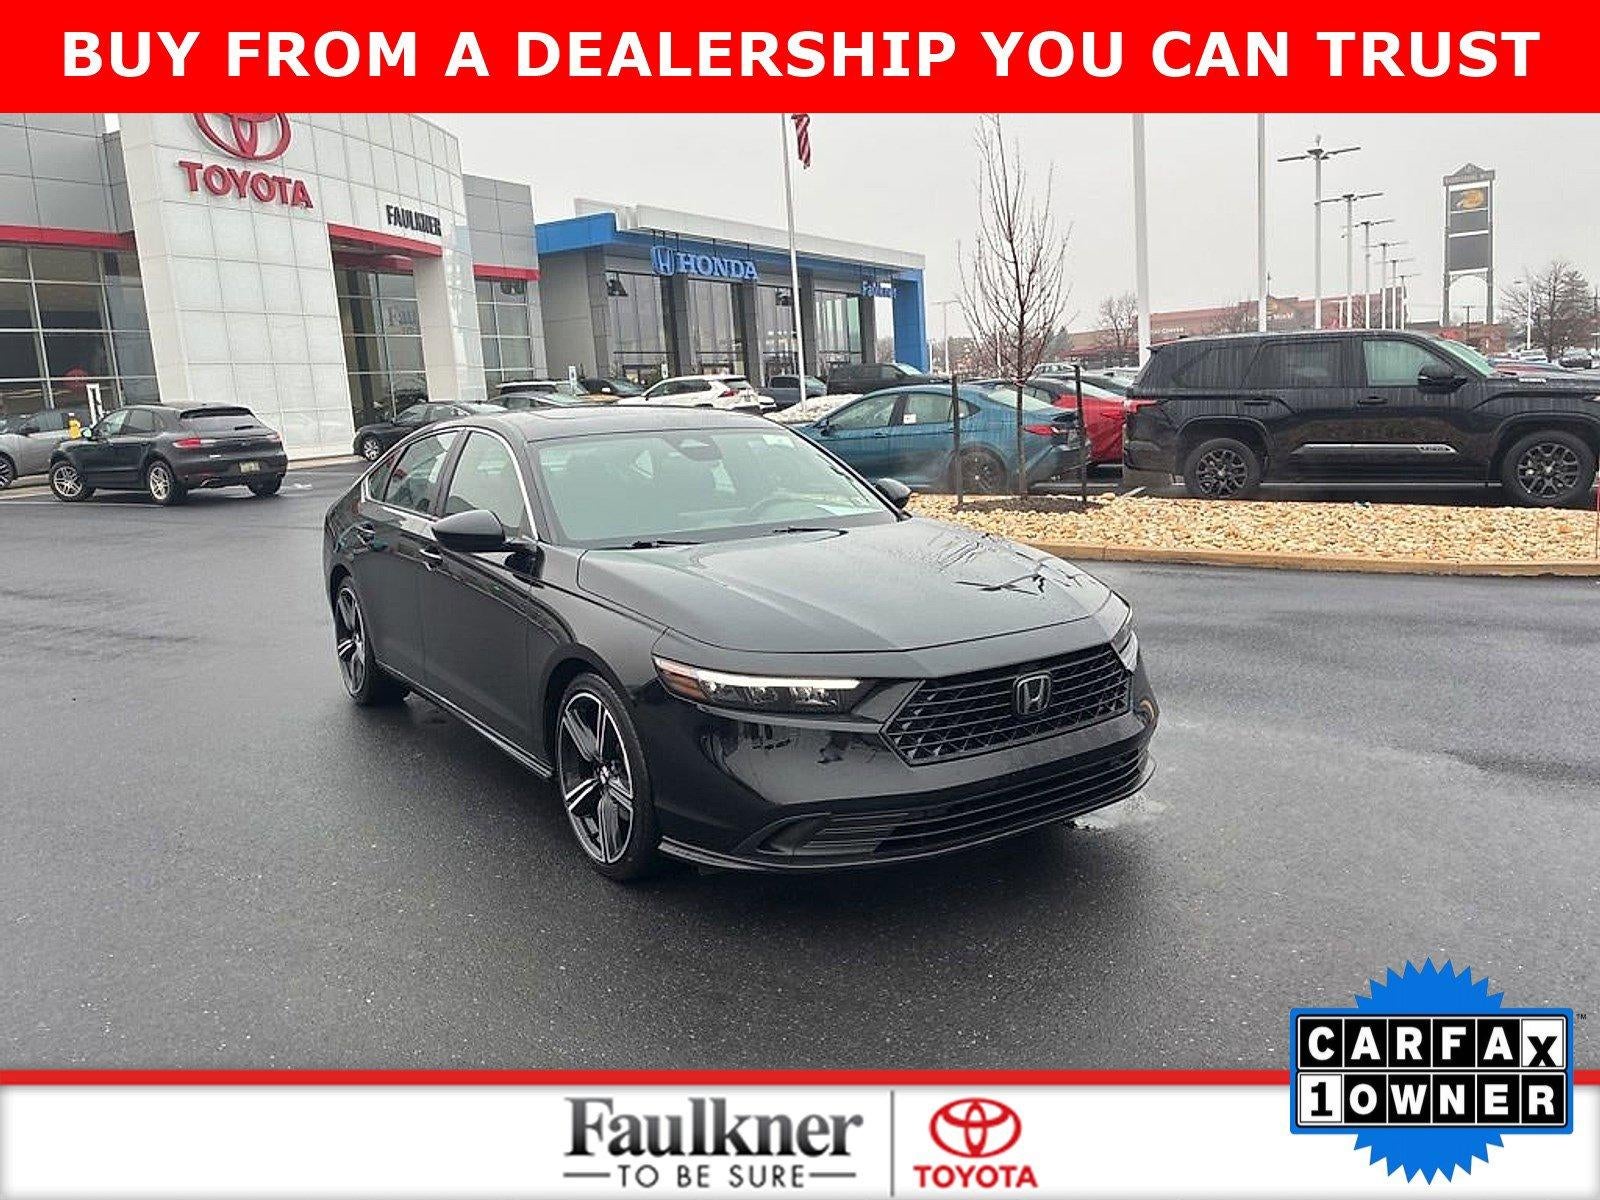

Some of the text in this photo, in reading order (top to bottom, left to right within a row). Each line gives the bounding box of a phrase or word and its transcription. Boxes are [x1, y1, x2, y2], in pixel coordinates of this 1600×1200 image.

[178, 160, 313, 208] TOYOTA
[386, 205, 441, 236] FAULKNER
[677, 252, 758, 279] HONDA
